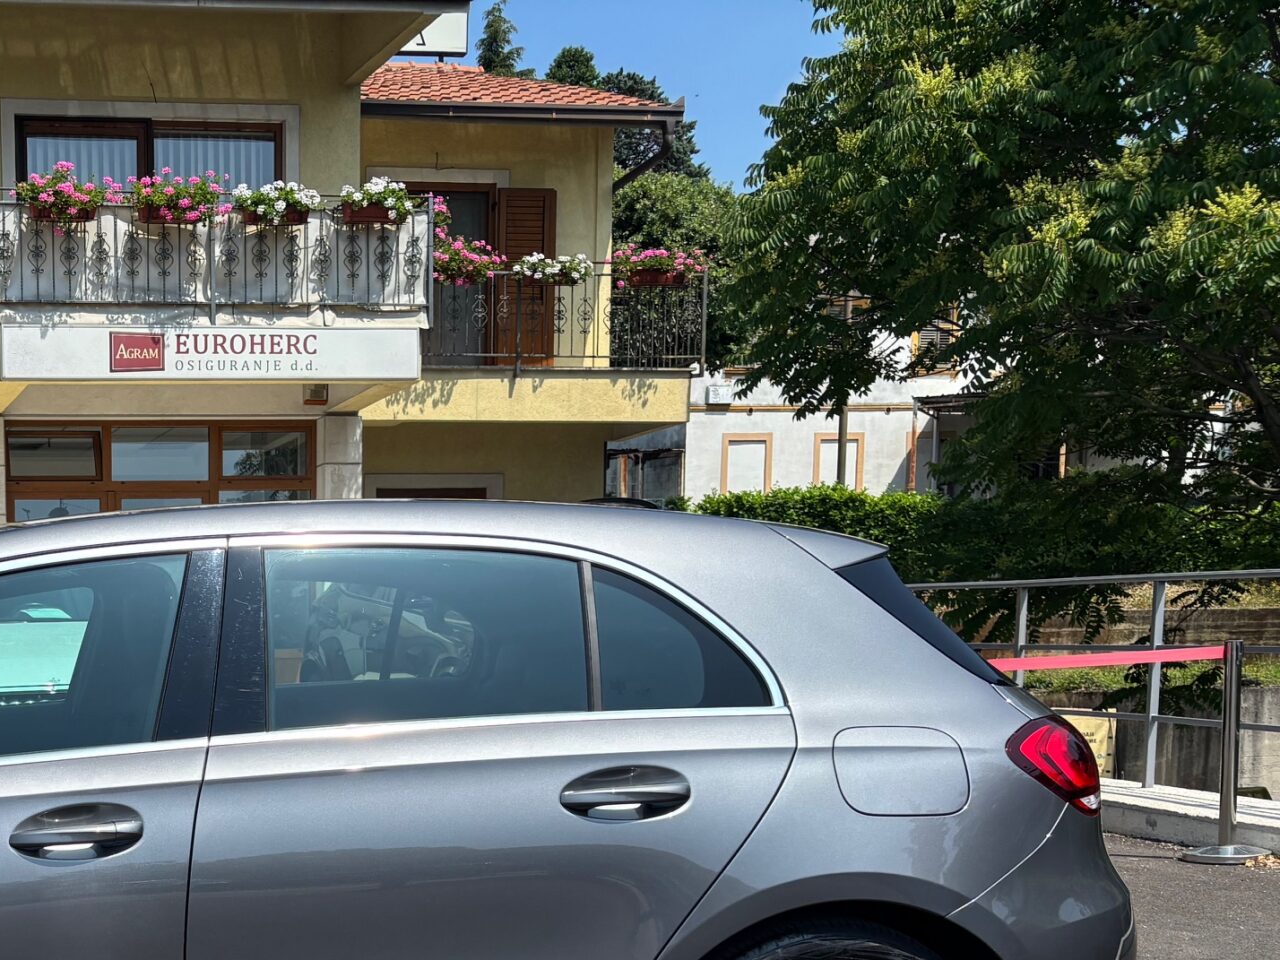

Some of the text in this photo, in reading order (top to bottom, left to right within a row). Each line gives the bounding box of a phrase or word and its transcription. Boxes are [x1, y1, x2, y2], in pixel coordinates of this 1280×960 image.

[115, 343, 160, 360] AGRAM
[174, 333, 318, 355] EUROHERC
[174, 359, 319, 372] OSIGURANJE d.d.
